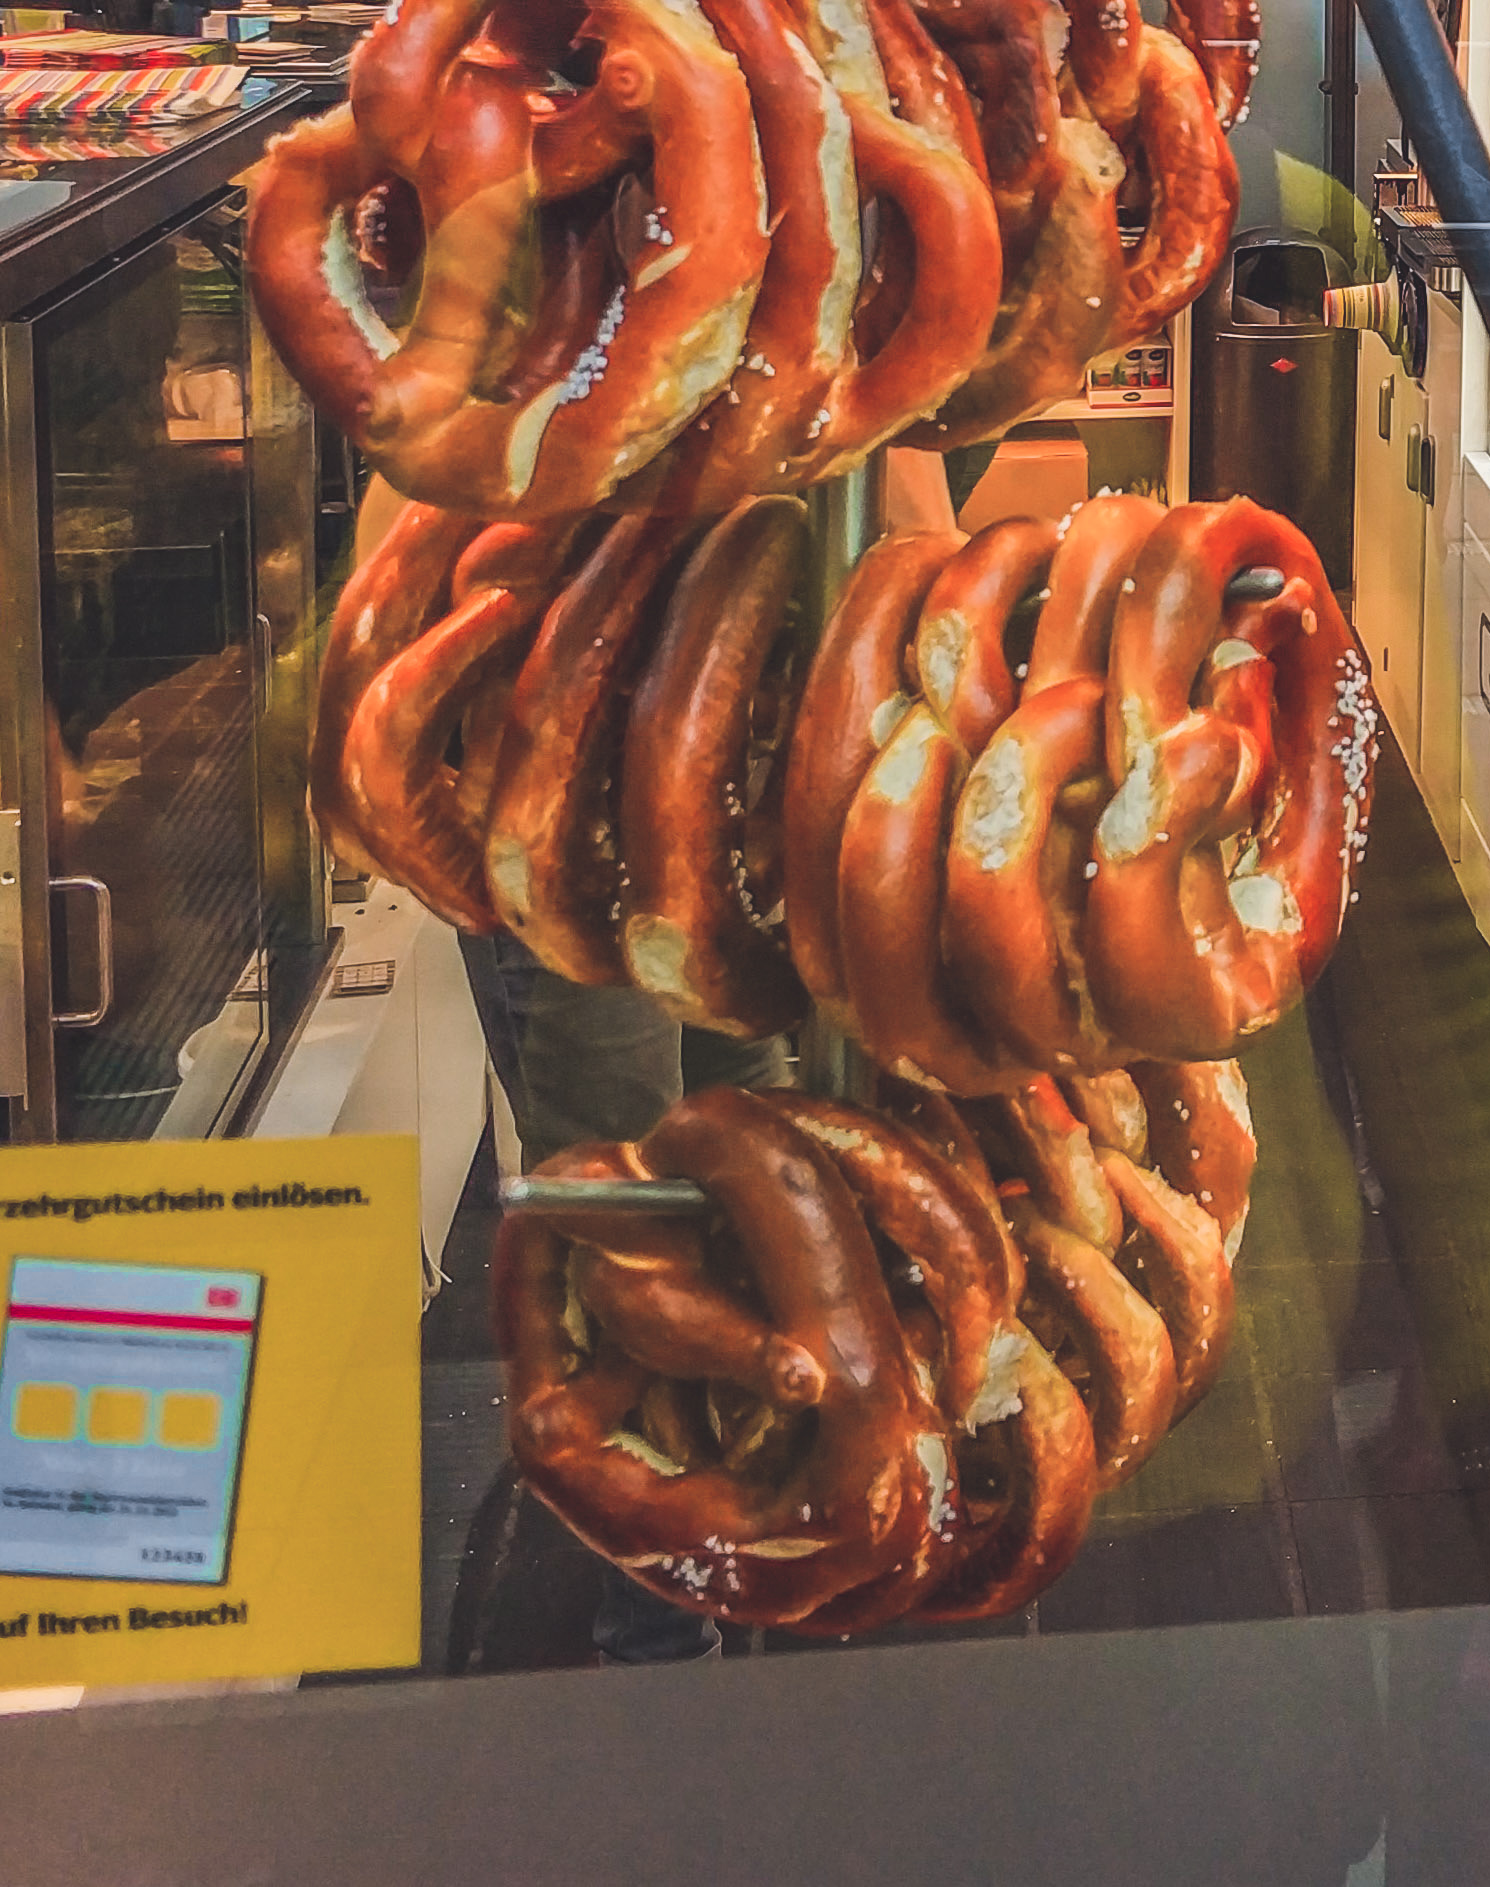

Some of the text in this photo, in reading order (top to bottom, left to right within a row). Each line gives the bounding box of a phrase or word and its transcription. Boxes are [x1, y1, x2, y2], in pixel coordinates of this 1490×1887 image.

[231, 1181, 369, 1210] einlösen.
[38, 1613, 120, 1637] Ihren
[128, 1600, 248, 1631] Besuch!
